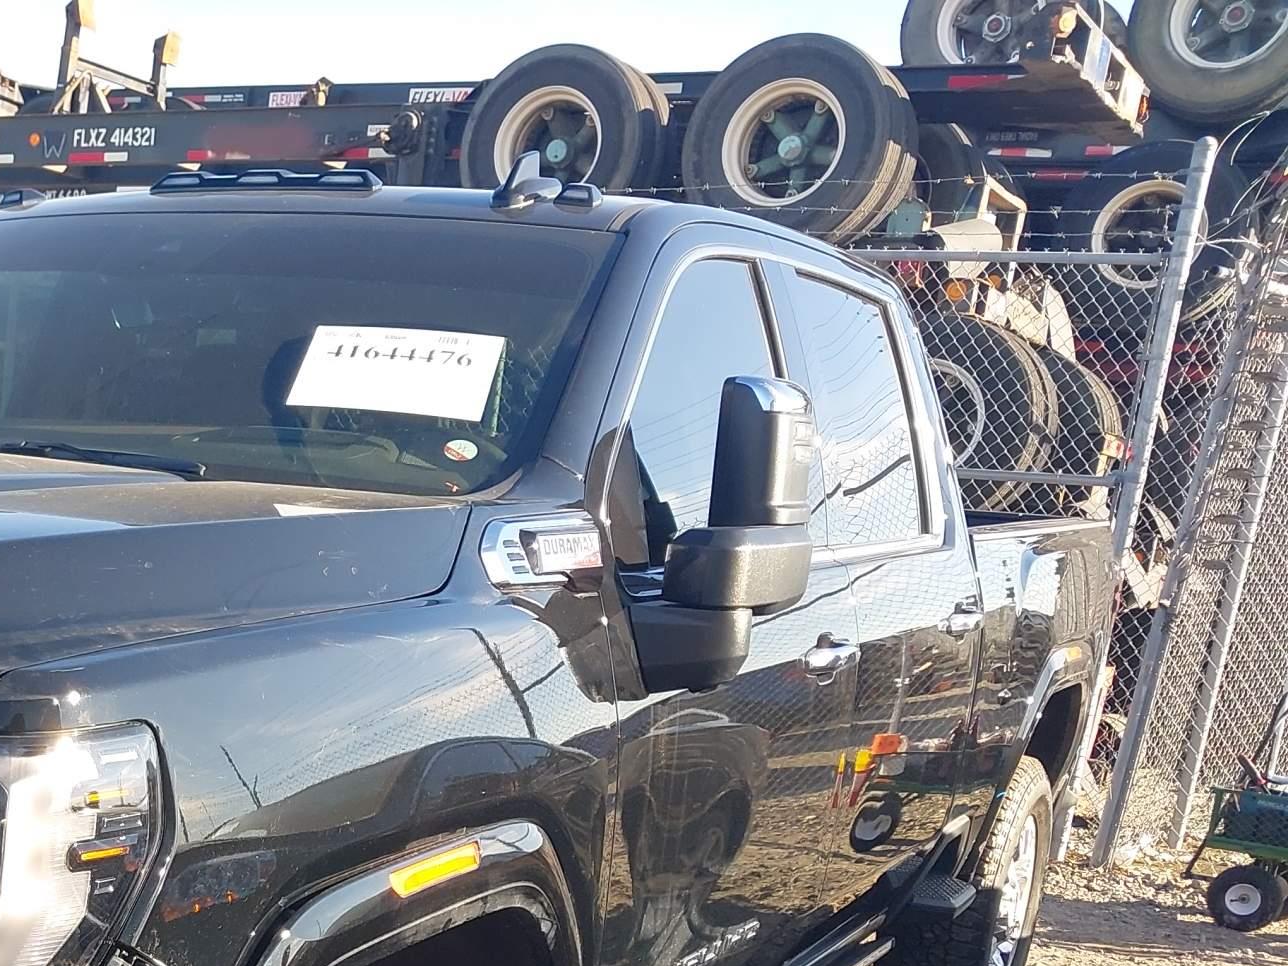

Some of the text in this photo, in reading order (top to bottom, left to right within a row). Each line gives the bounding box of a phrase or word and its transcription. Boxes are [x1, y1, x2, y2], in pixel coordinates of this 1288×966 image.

[73, 127, 156, 148] FLXZ 414321
[327, 344, 472, 367] 41644476
[543, 534, 595, 556] DURAMAX
